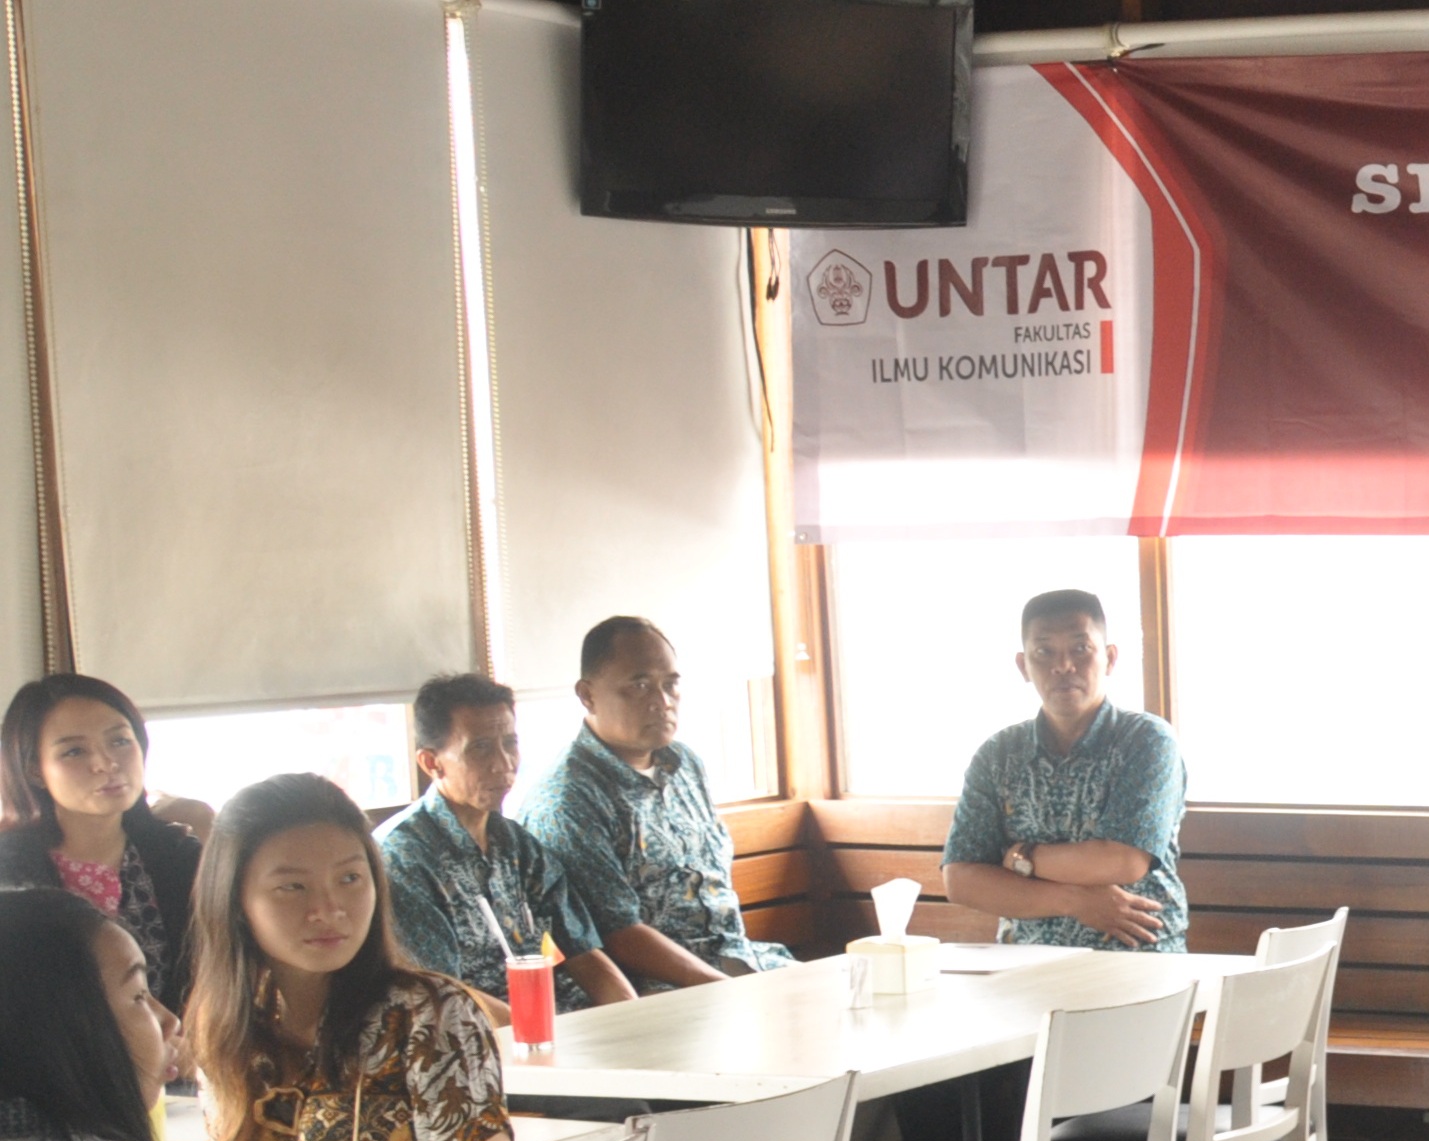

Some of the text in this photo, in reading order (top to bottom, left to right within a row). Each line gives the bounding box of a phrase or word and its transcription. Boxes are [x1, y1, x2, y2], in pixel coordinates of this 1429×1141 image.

[883, 250, 1112, 320] UNTAR
[1014, 322, 1091, 344] FAKULTAS
[871, 349, 1092, 384] ILMU KOMUNIKASI
